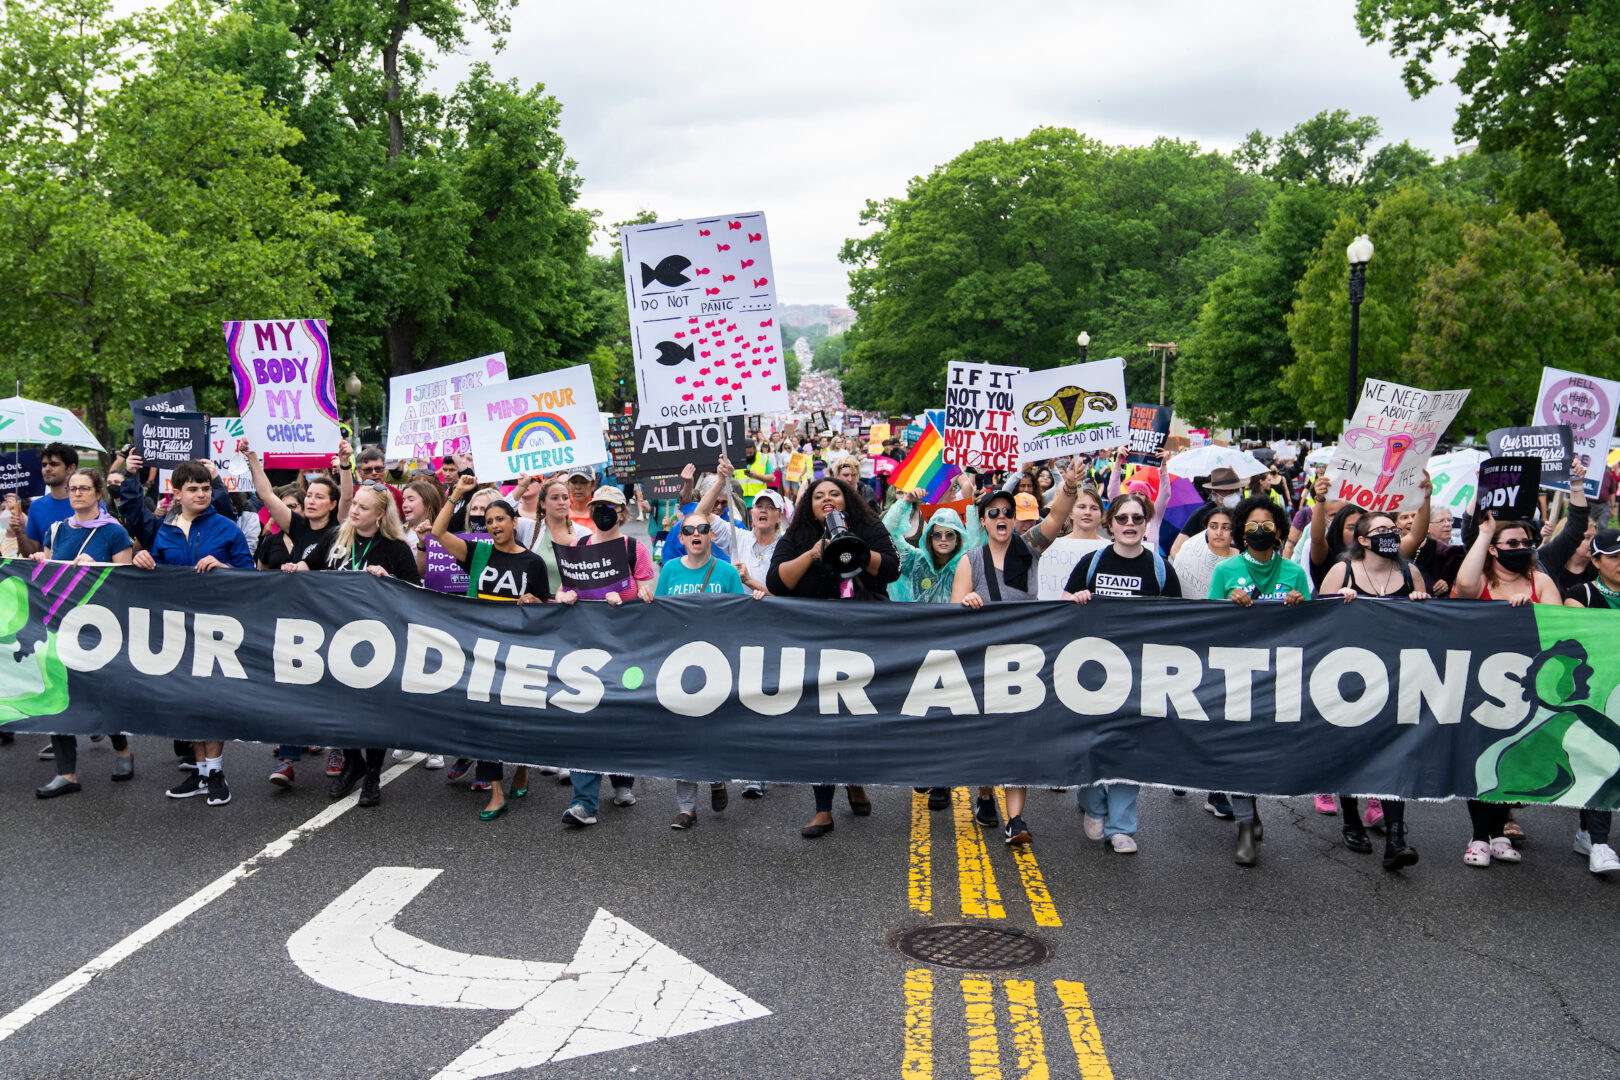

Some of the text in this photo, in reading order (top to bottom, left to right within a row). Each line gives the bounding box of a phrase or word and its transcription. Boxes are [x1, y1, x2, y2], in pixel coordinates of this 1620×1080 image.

[641, 299, 659, 312] DO
[667, 295, 690, 308] NOT
[700, 301, 734, 314] PANIC
[254, 322, 295, 351] MY
[252, 357, 309, 385] BODY
[405, 370, 483, 404] I JUST TOOK
[1568, 376, 1595, 390] HELL
[265, 389, 302, 420] MY
[486, 397, 529, 421] MIND
[531, 387, 576, 412] YOUR
[947, 387, 1014, 411] NOT YOU
[1365, 382, 1468, 411] WE NEED TO TALK
[1568, 392, 1589, 404] Hath
[404, 405, 417, 420] A
[419, 398, 449, 418] DNA
[660, 402, 732, 418] ORGANIZE
[945, 405, 986, 429] BODY
[1131, 406, 1158, 419] FIGHT
[1380, 404, 1436, 423] ABOUT THE
[1552, 402, 1600, 420] NO FURY
[142, 423, 190, 439] Our BODIES
[266, 424, 315, 443] CHOICE
[1130, 418, 1154, 431] BACK.
[1365, 415, 1443, 435] ELEPHANT
[1579, 423, 1586, 432] A
[142, 438, 194, 453] OUR Futures
[529, 437, 545, 448] OWN
[641, 421, 733, 454] ALITO!
[944, 428, 976, 449] NOT
[980, 431, 1020, 454] YOUR
[1023, 425, 1122, 453] DON'T TREAD ON ME
[1128, 428, 1166, 444] PROTECT
[1500, 433, 1561, 451] Our BODIES
[143, 448, 191, 462] Our ABORTIONS
[413, 435, 472, 458] MY BOD
[1127, 439, 1159, 454] CHOICE.
[6, 462, 22, 471] Out
[507, 446, 575, 473] UTERUS
[1501, 465, 1509, 473] IS
[1336, 458, 1417, 488] IN THE
[1338, 479, 1406, 512] WOMB
[1480, 485, 1521, 511] BODY
[560, 557, 612, 571] Abortion is
[563, 568, 620, 581] Health Care.
[1097, 575, 1140, 588] STAND
[708, 583, 722, 593] TO
[56, 603, 1533, 730] OUR BODIES OUR ABORTIONS
